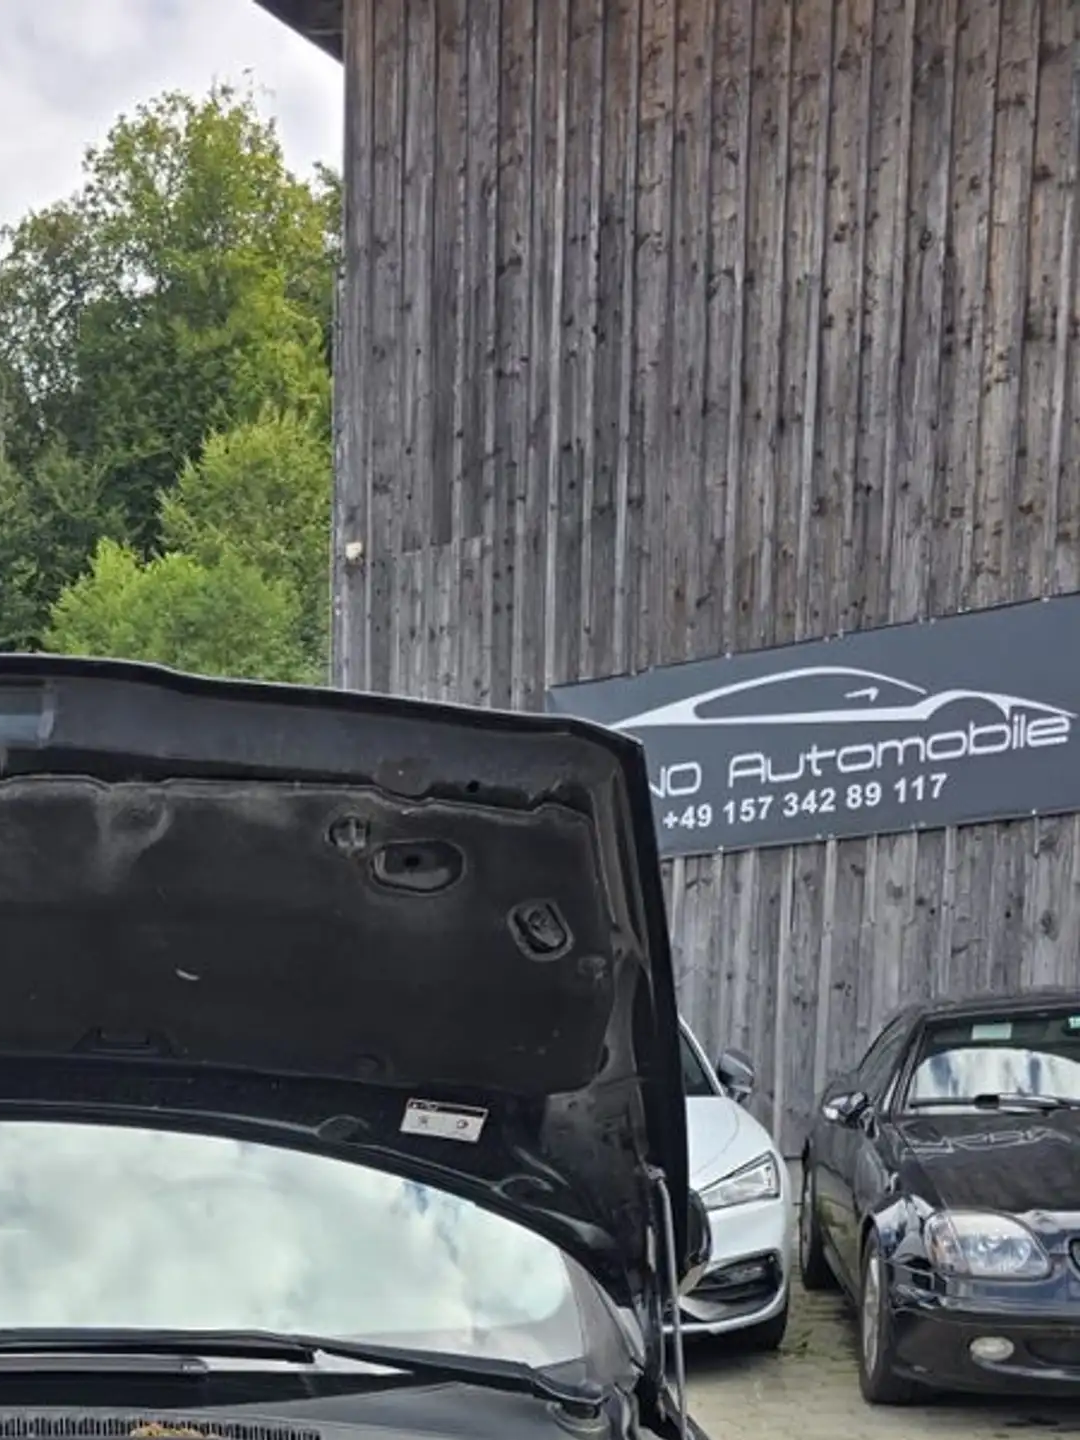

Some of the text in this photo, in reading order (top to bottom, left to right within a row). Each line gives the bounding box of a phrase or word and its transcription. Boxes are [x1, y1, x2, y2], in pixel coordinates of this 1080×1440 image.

[728, 713, 1071, 788] Automobile
[663, 773, 947, 829] +49 157 342 89 117
